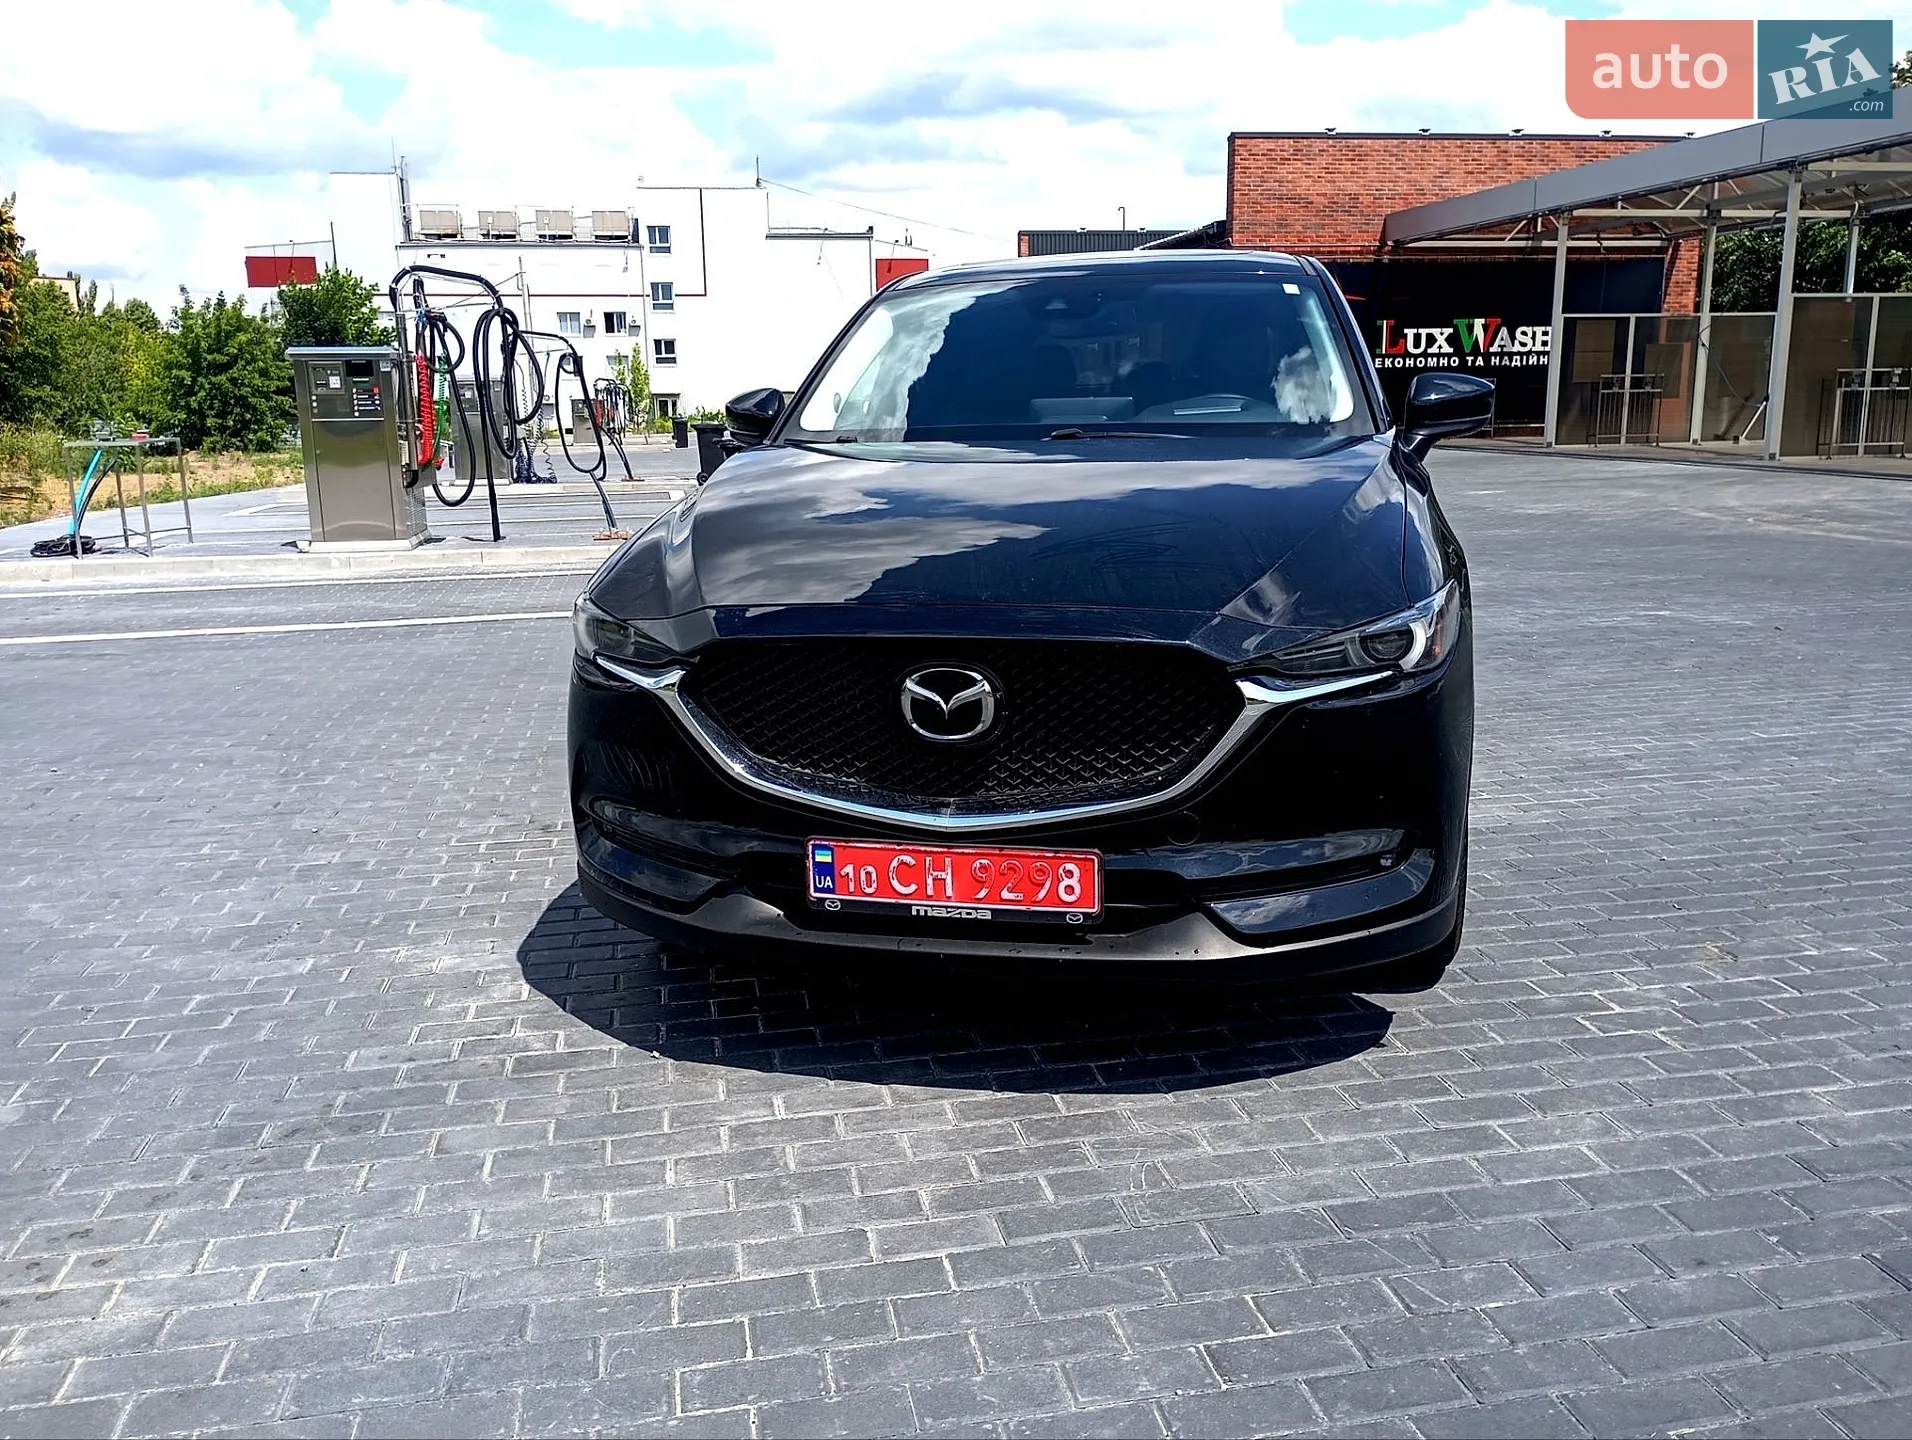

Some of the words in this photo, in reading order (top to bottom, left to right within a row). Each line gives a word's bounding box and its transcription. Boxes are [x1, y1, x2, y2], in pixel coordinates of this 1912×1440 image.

[1375, 356, 1460, 368] ЕКОНОМНО
[1466, 356, 1485, 367] ТА
[1491, 353, 1549, 367] НАДІЙН
[816, 874, 834, 890] UA
[839, 863, 879, 895] 10
[888, 854, 955, 898] CH
[970, 857, 1083, 904] 9298
